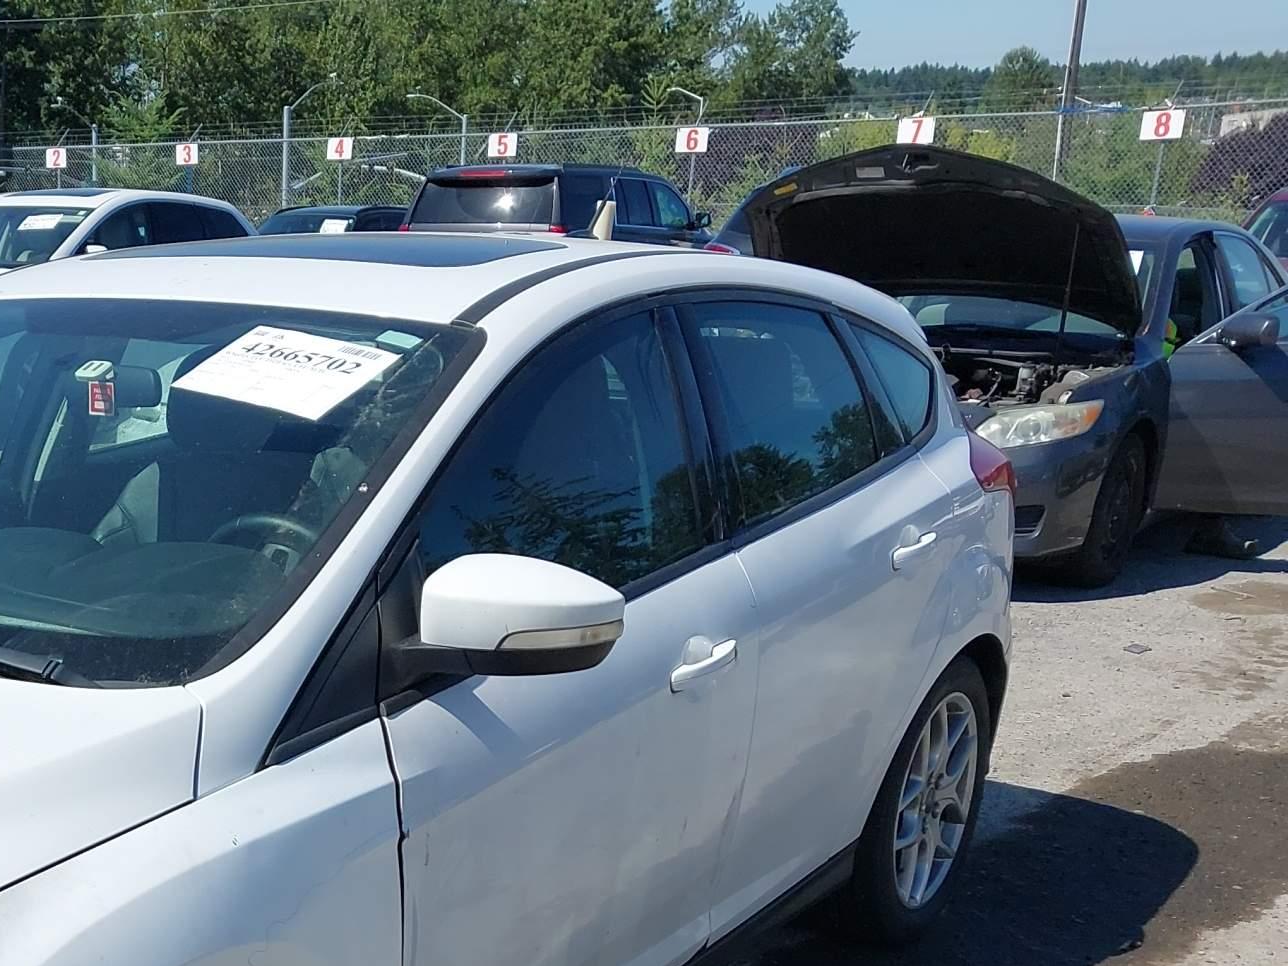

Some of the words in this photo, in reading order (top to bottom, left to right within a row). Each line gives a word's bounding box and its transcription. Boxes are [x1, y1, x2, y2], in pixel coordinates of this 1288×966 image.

[911, 119, 924, 144] 7
[1153, 112, 1172, 137] 8
[334, 139, 345, 158] 4
[496, 134, 509, 155] 5
[686, 129, 699, 151] 6
[52, 148, 61, 166] 2
[183, 145, 192, 163] 3
[241, 342, 363, 375] 42665702
